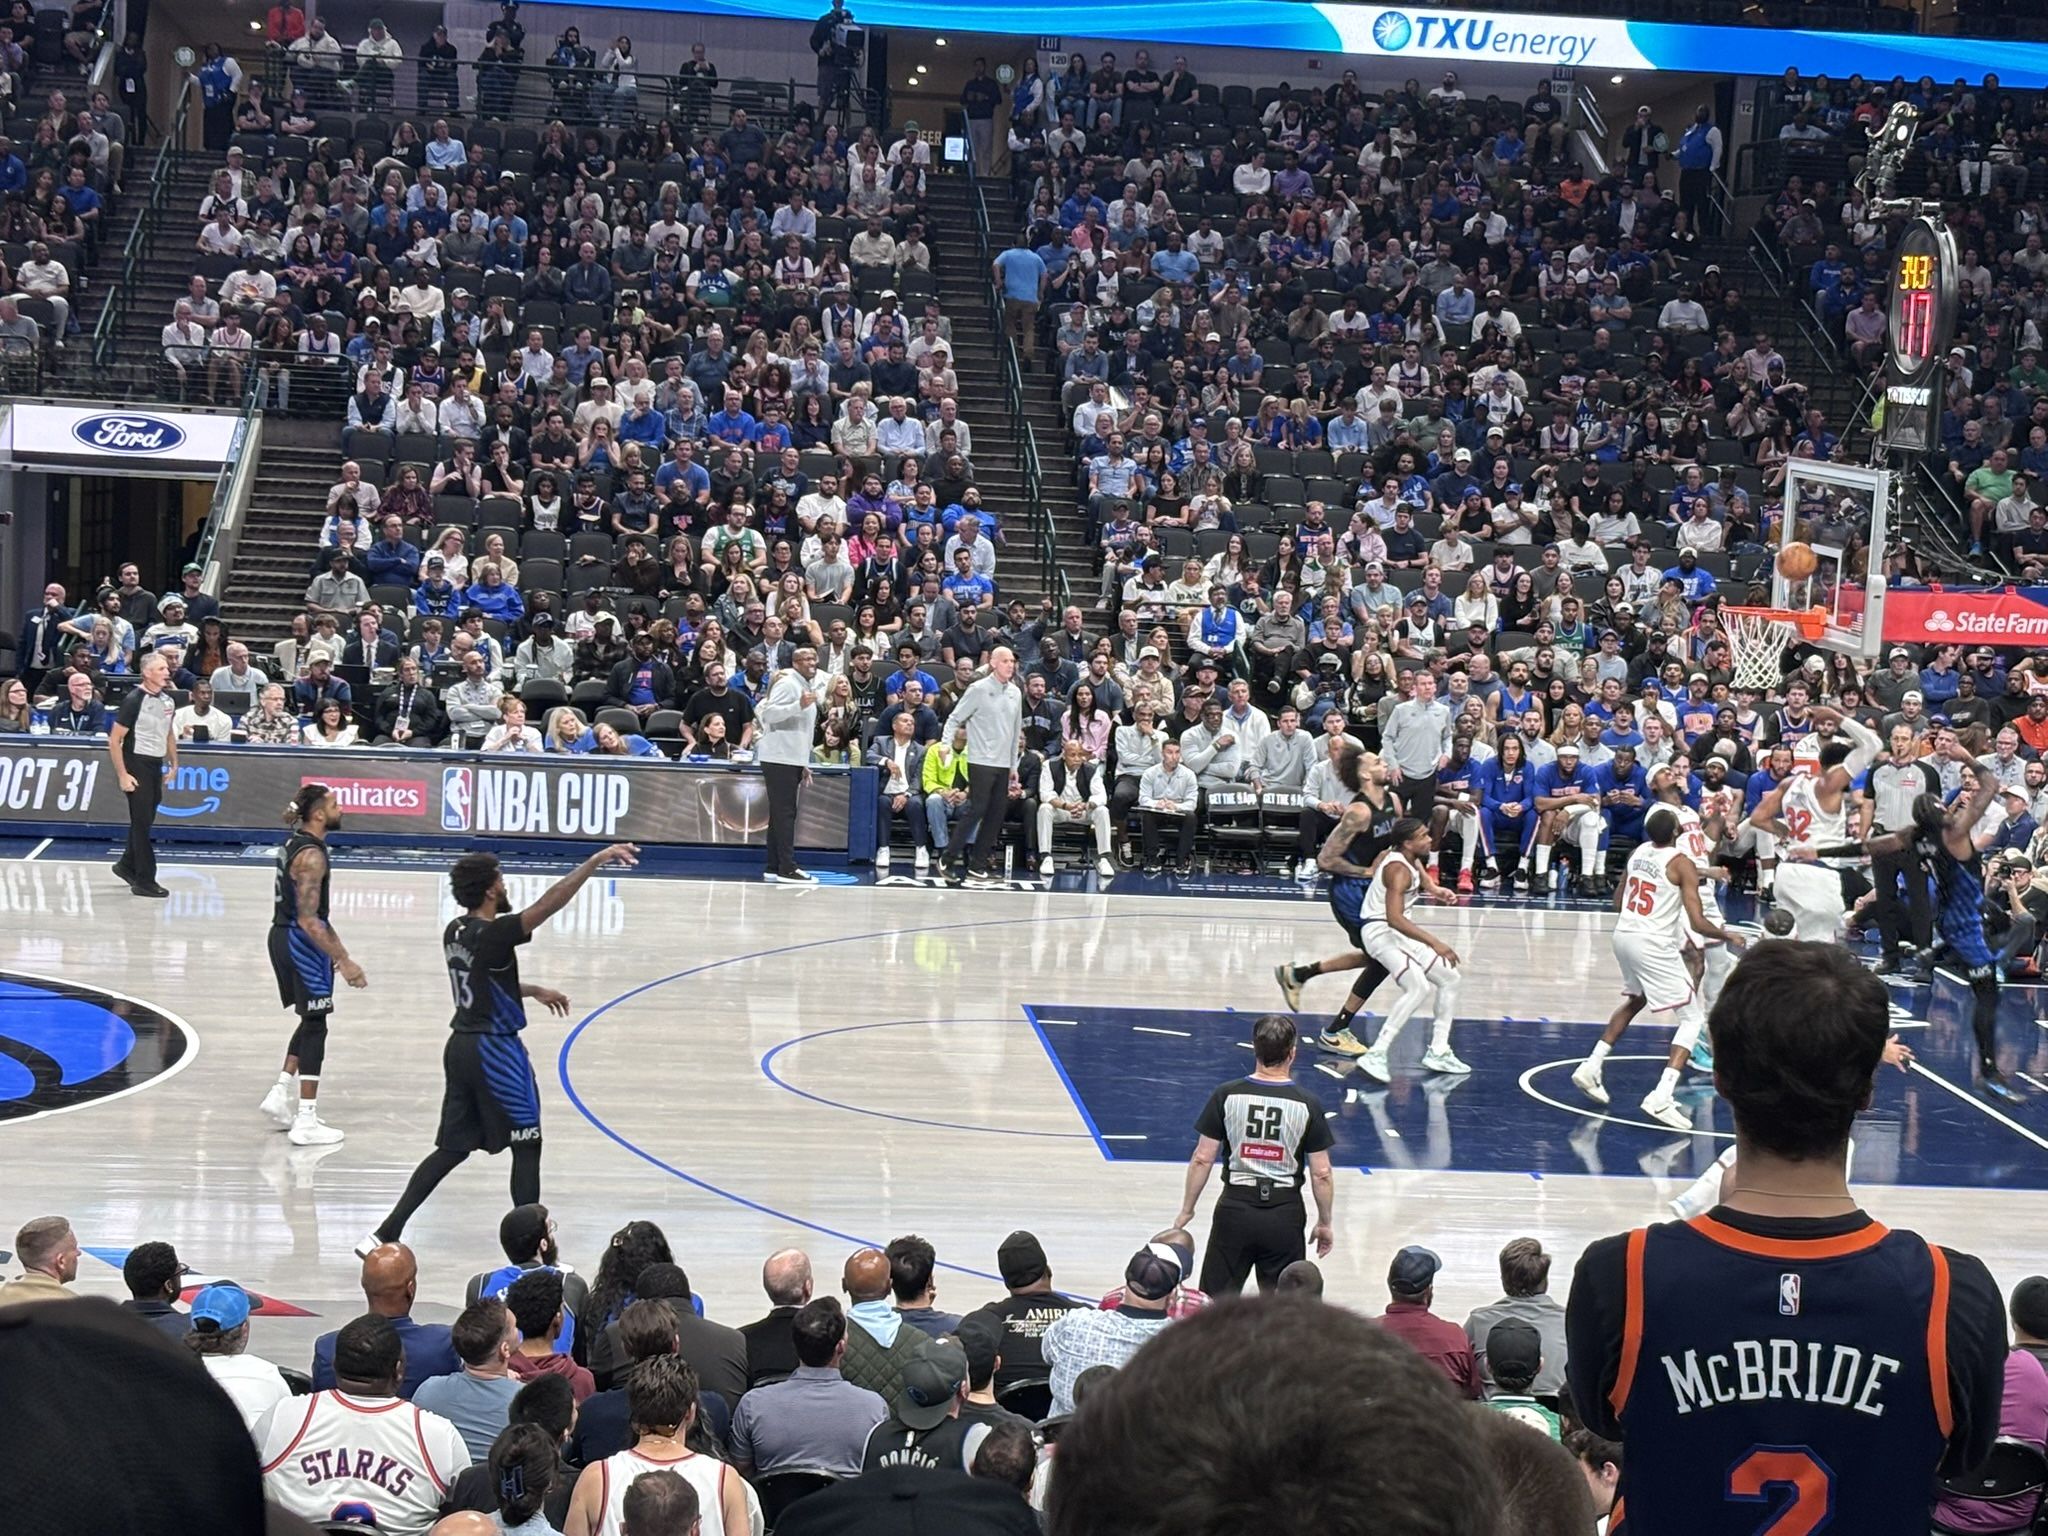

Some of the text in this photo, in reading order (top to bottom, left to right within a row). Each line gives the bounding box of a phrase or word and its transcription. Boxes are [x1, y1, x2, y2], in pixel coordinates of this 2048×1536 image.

[1040, 36, 1058, 49] EXIT
[1051, 54, 1067, 66] 120
[1552, 83, 1568, 95] 120
[94, 418, 164, 448] Ford
[57, 759, 99, 812] 31
[158, 764, 230, 792] ime
[331, 781, 420, 807] mirates
[476, 769, 630, 836] NBA CUP
[1208, 793, 1222, 805] GET
[1223, 793, 1236, 805] THE
[1262, 793, 1275, 804] GET
[1276, 793, 1290, 806] THE
[1785, 806, 1813, 843] 32
[1625, 875, 1658, 917] 25
[450, 967, 474, 1009] 13
[510, 1126, 540, 1142] MAVS
[1245, 1103, 1283, 1141] 52
[1243, 1145, 1281, 1158] Emirates
[1660, 1338, 1901, 1417] McBRIDE
[299, 1446, 416, 1497] STARKS
[1724, 1442, 1838, 1536] 2
